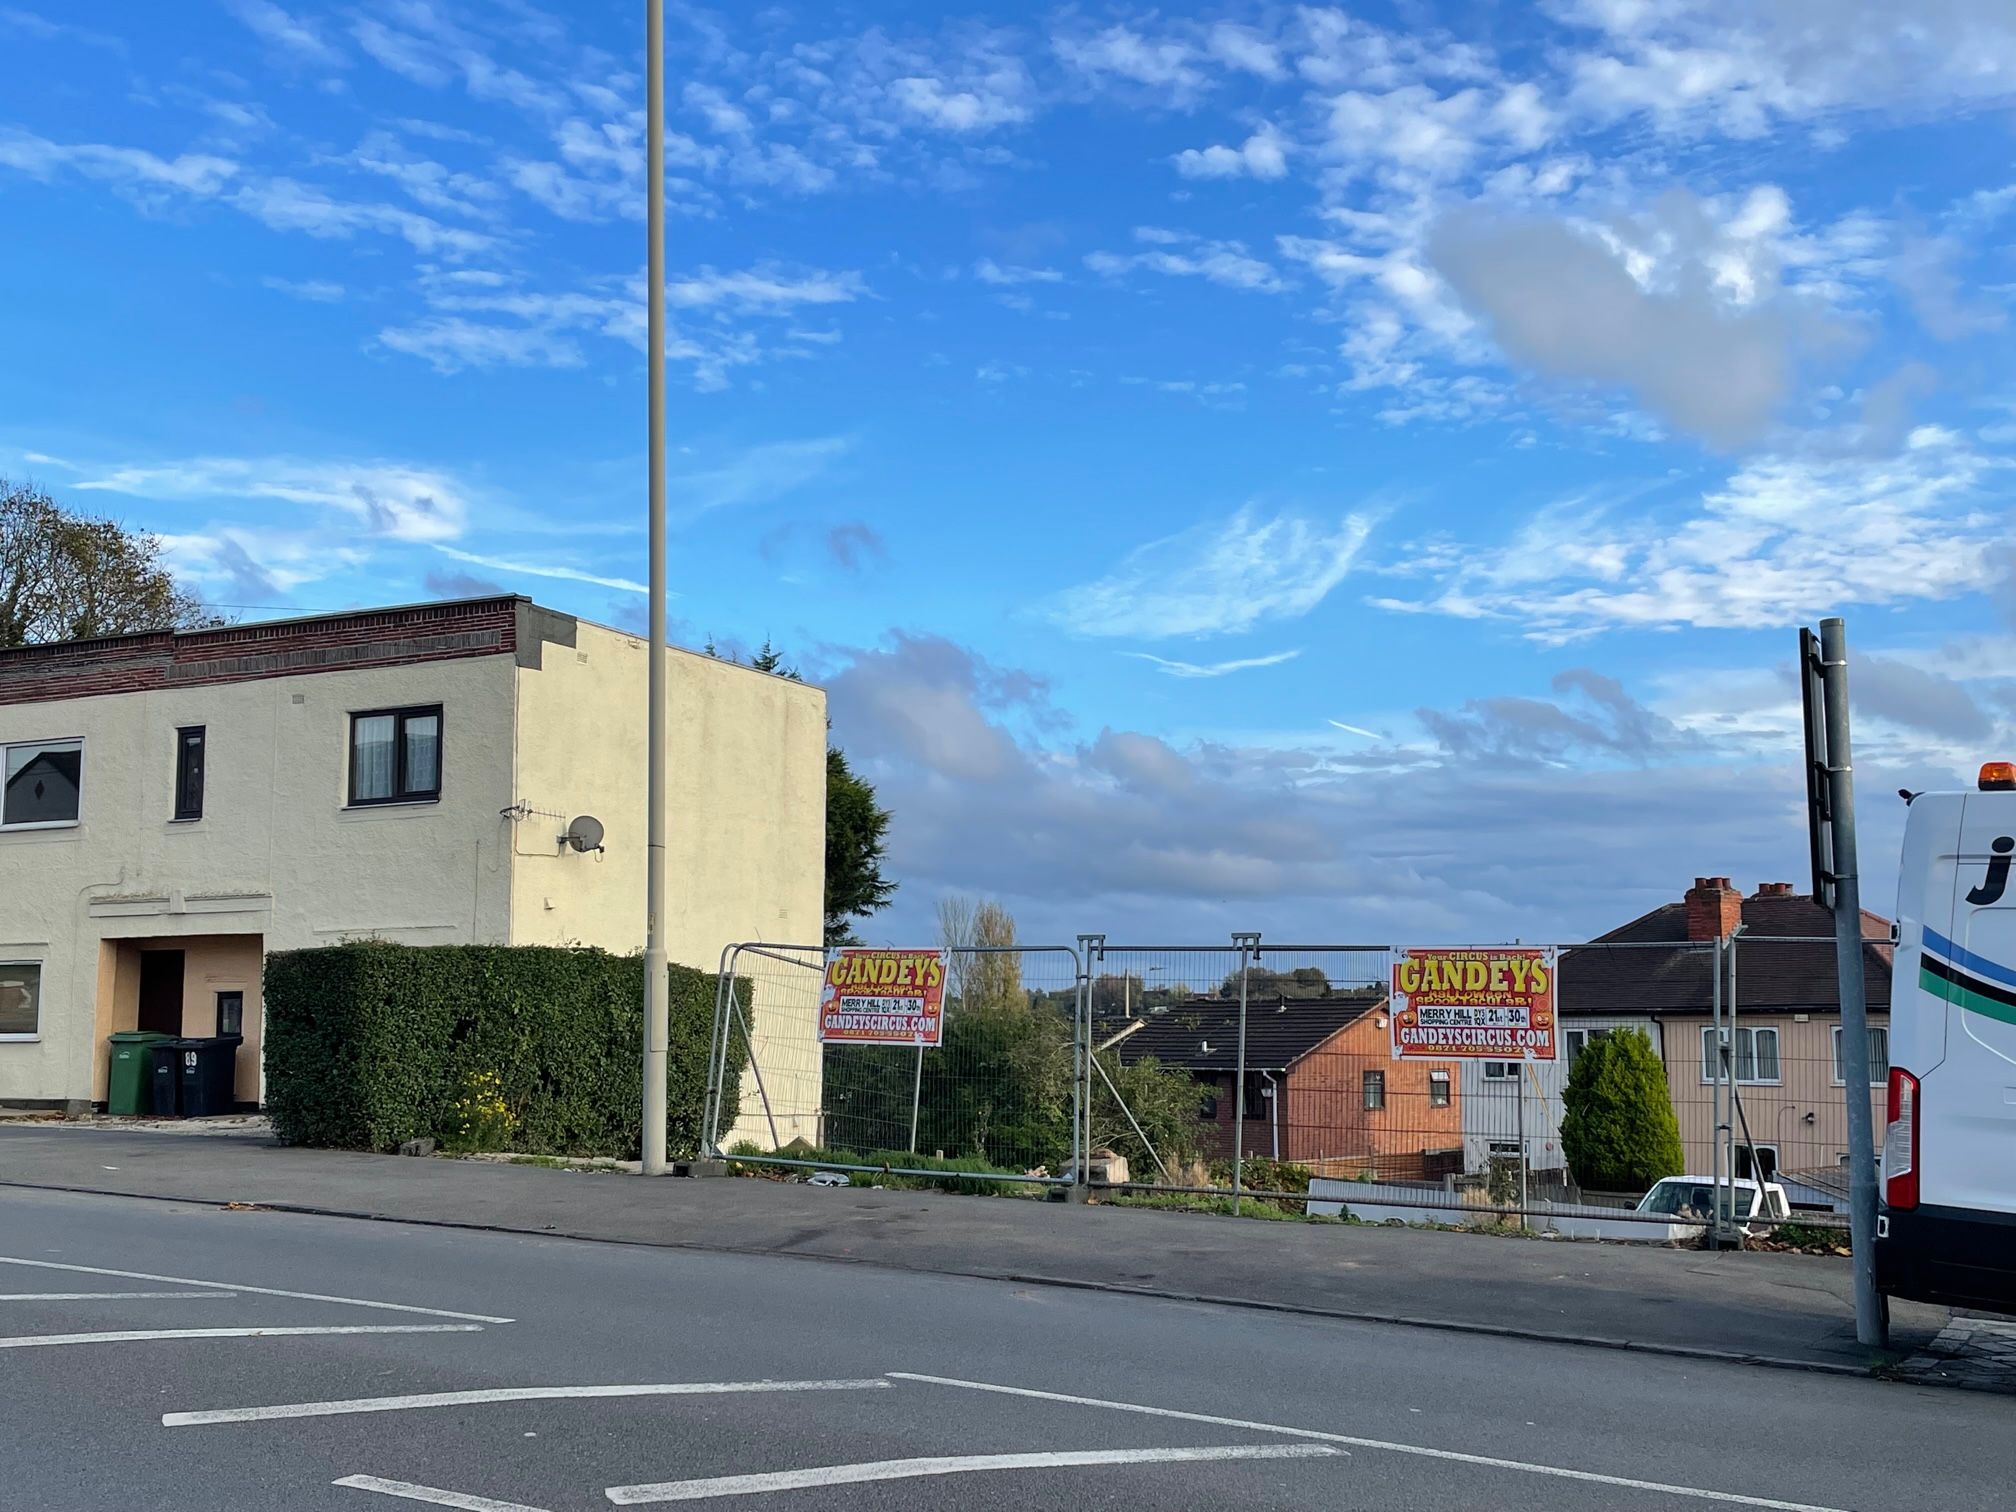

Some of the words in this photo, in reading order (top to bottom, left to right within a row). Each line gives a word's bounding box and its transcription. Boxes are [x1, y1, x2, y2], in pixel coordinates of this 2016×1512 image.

[871, 951, 900, 959] CIRCUS
[1449, 952, 1489, 960] CIRCUS
[831, 957, 941, 987] GANDEYS
[1400, 958, 1549, 994] GANDEYS
[841, 999, 866, 1007] MERRY
[867, 999, 880, 1008] HILL
[1420, 1009, 1452, 1019] MERRY
[1454, 1009, 1472, 1019] HILL
[824, 1014, 935, 1031] GANDEYSCIRCUS.COM
[1400, 1027, 1549, 1047] GANDEYSCIRCUS.COM
[185, 1051, 197, 1066] 89
